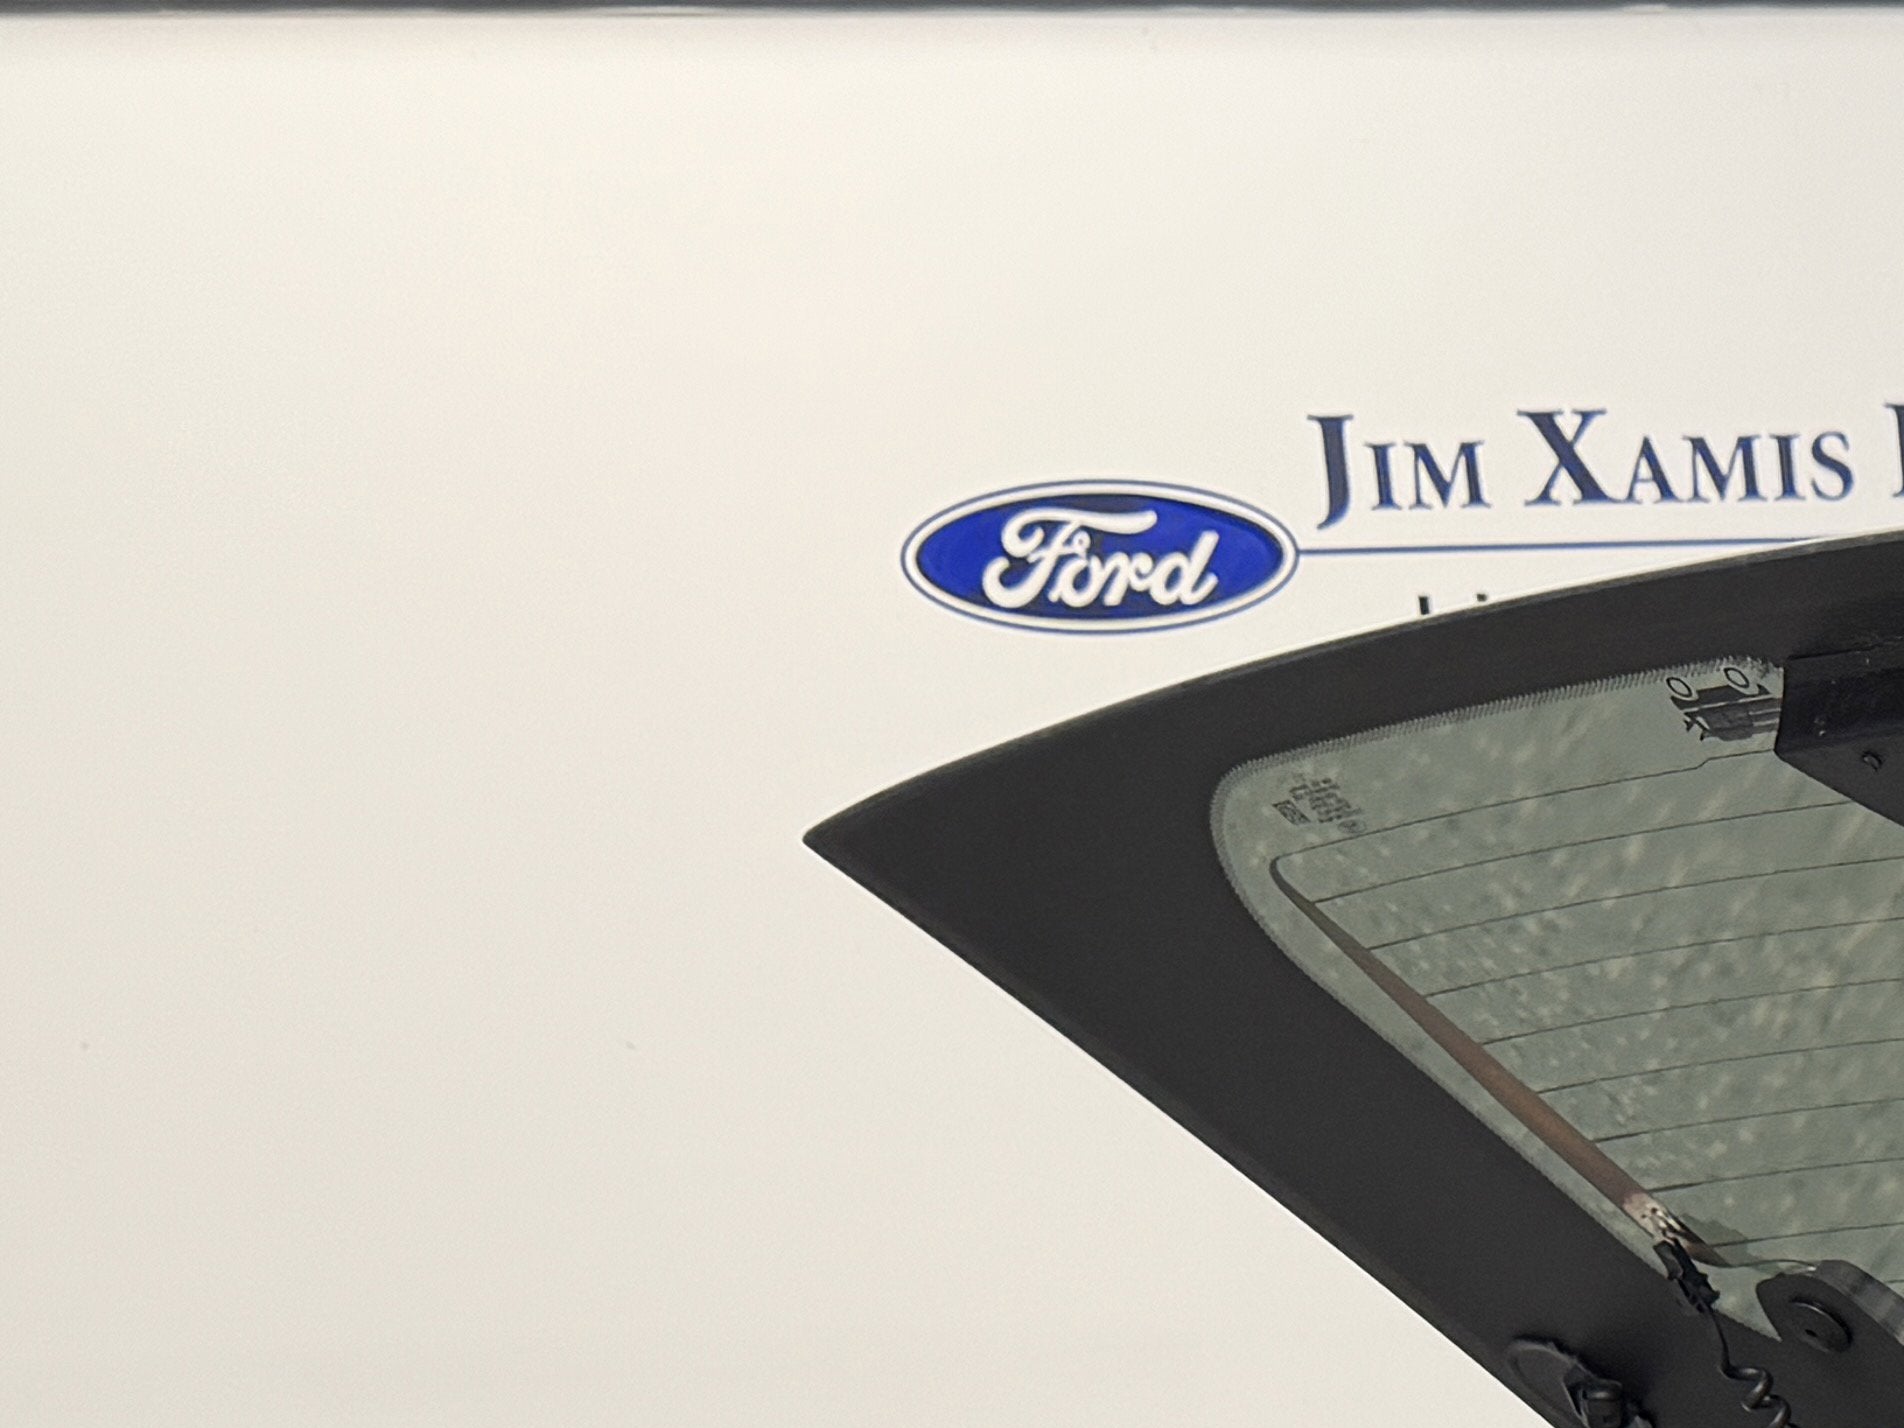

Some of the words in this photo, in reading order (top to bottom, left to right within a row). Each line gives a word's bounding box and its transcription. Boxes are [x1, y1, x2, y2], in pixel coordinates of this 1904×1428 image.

[1306, 413, 1492, 530] JIM
[1516, 408, 1855, 507] XAMIS
[982, 506, 1219, 609] Ford
